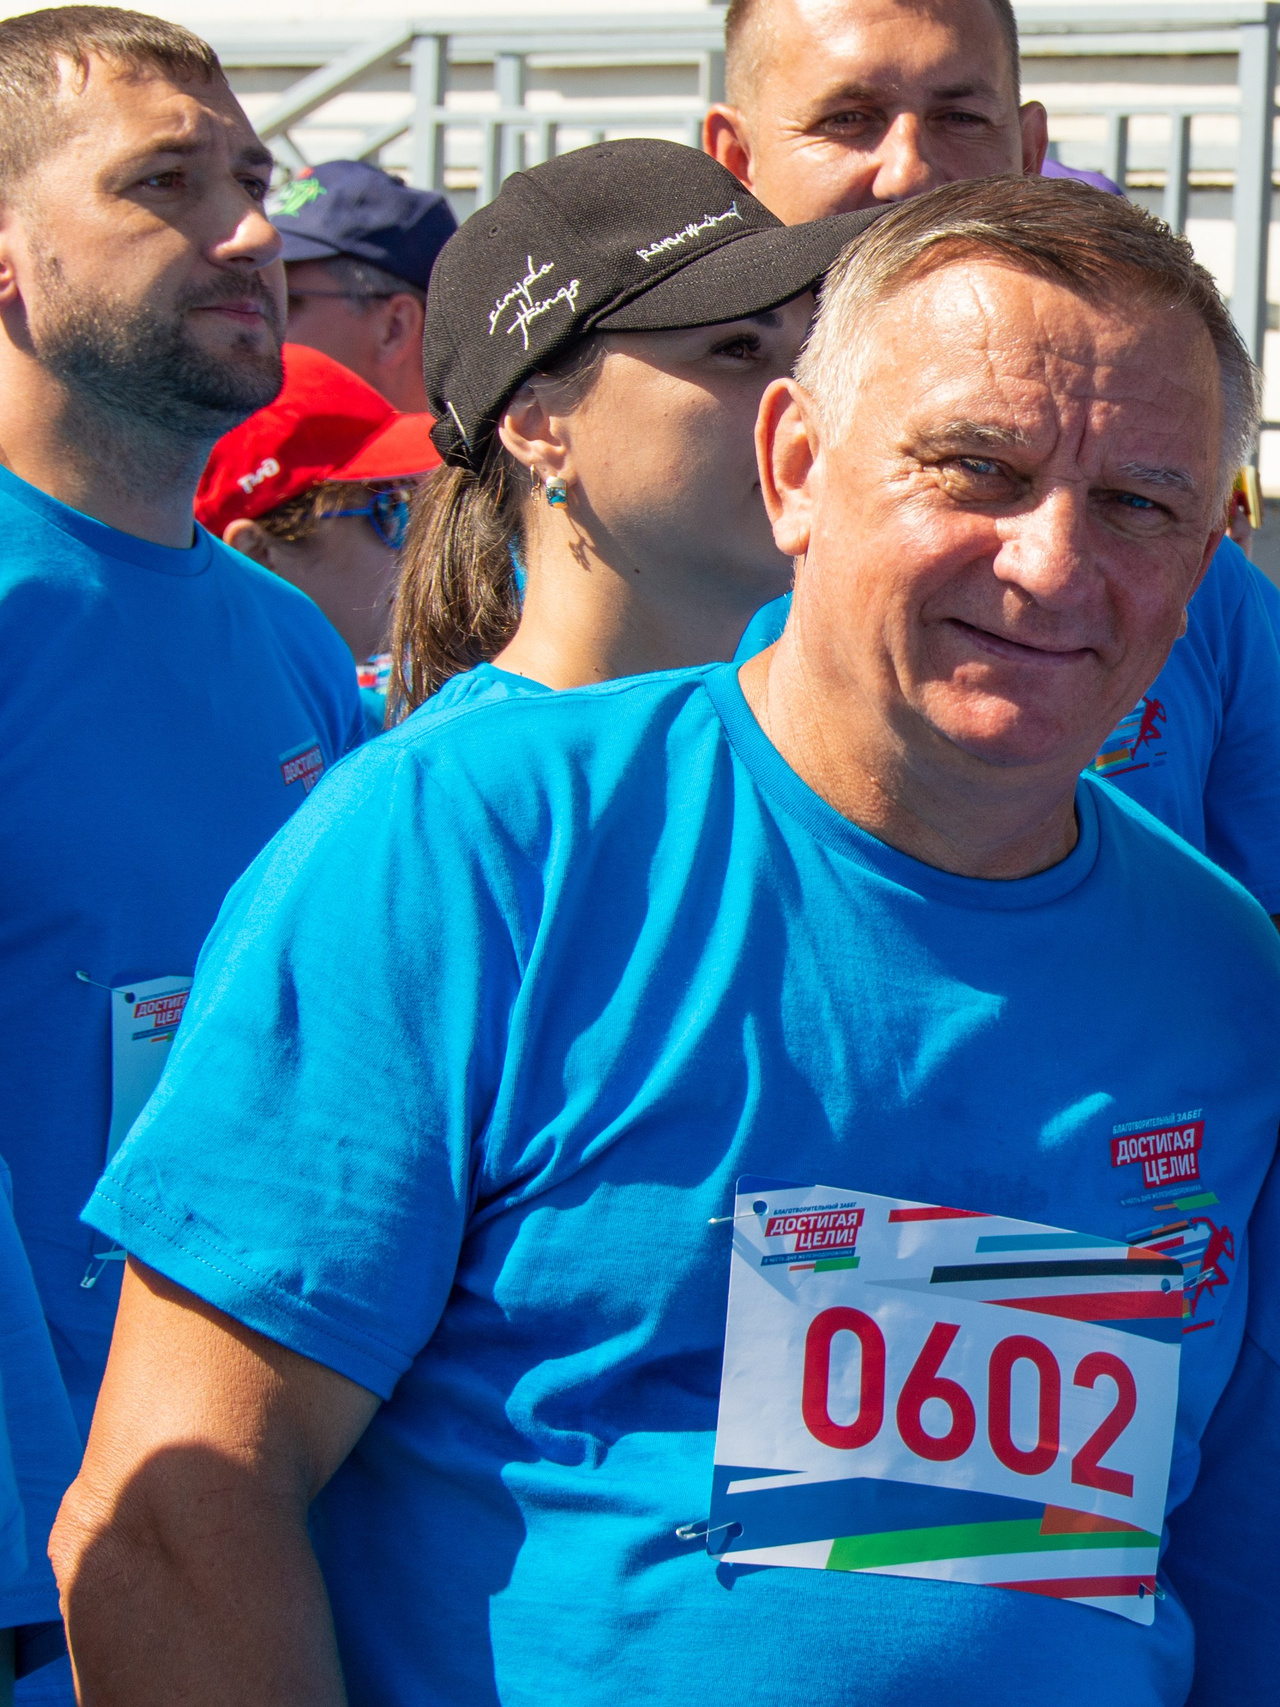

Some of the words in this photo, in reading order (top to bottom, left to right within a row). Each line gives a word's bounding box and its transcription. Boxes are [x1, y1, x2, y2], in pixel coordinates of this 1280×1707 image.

[1177, 1108, 1203, 1123] ЗАБЕГ
[1116, 1128, 1195, 1165] ДОСТИГАЯ
[1144, 1153, 1197, 1185] ЦЕЛИ!
[773, 1203, 839, 1215] БЛАГОТВОРИТЕЛЬНЫЙ
[839, 1201, 857, 1209] ЗАБЕГ
[770, 1212, 858, 1236] ДОСТИГАЯ
[799, 1228, 855, 1249] ЦЕЛИ!
[801, 1305, 1137, 1499] 0602
